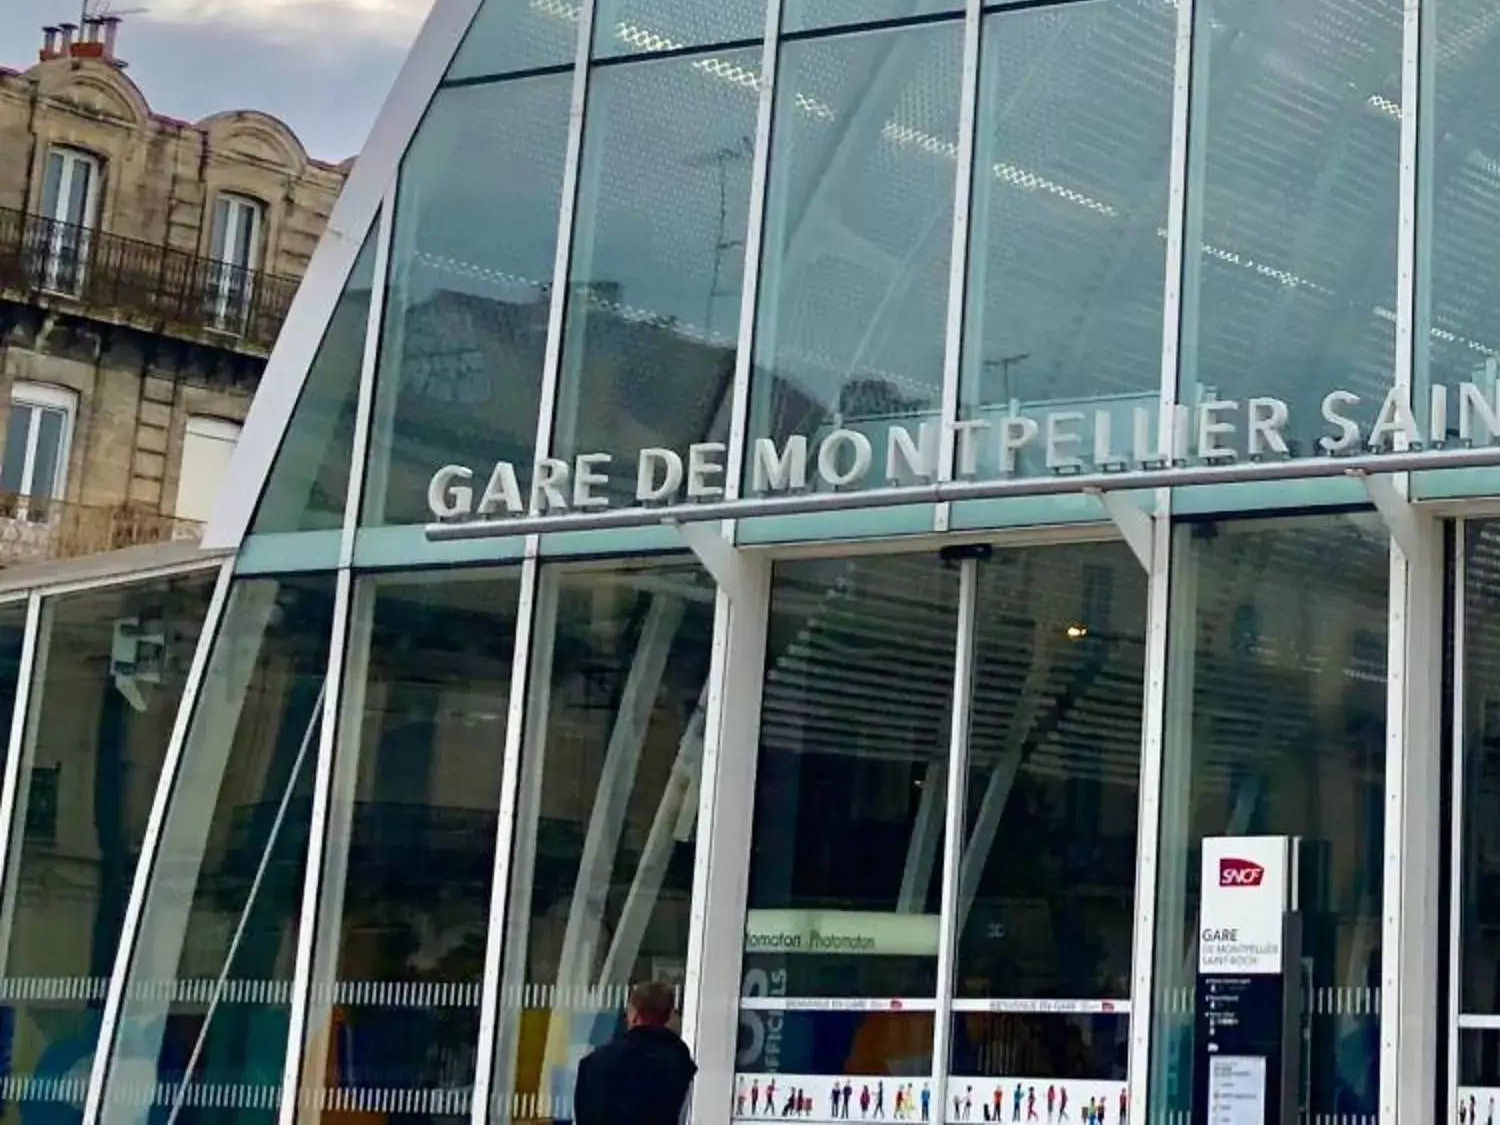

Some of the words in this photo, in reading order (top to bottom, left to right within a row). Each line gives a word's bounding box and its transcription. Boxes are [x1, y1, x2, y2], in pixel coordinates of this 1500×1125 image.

[427, 449, 612, 517] GARE
[636, 442, 727, 501] DE
[752, 396, 1289, 492] MONTPELLIER
[1221, 868, 1261, 884] SNCF
[1202, 928, 1240, 942] GARE
